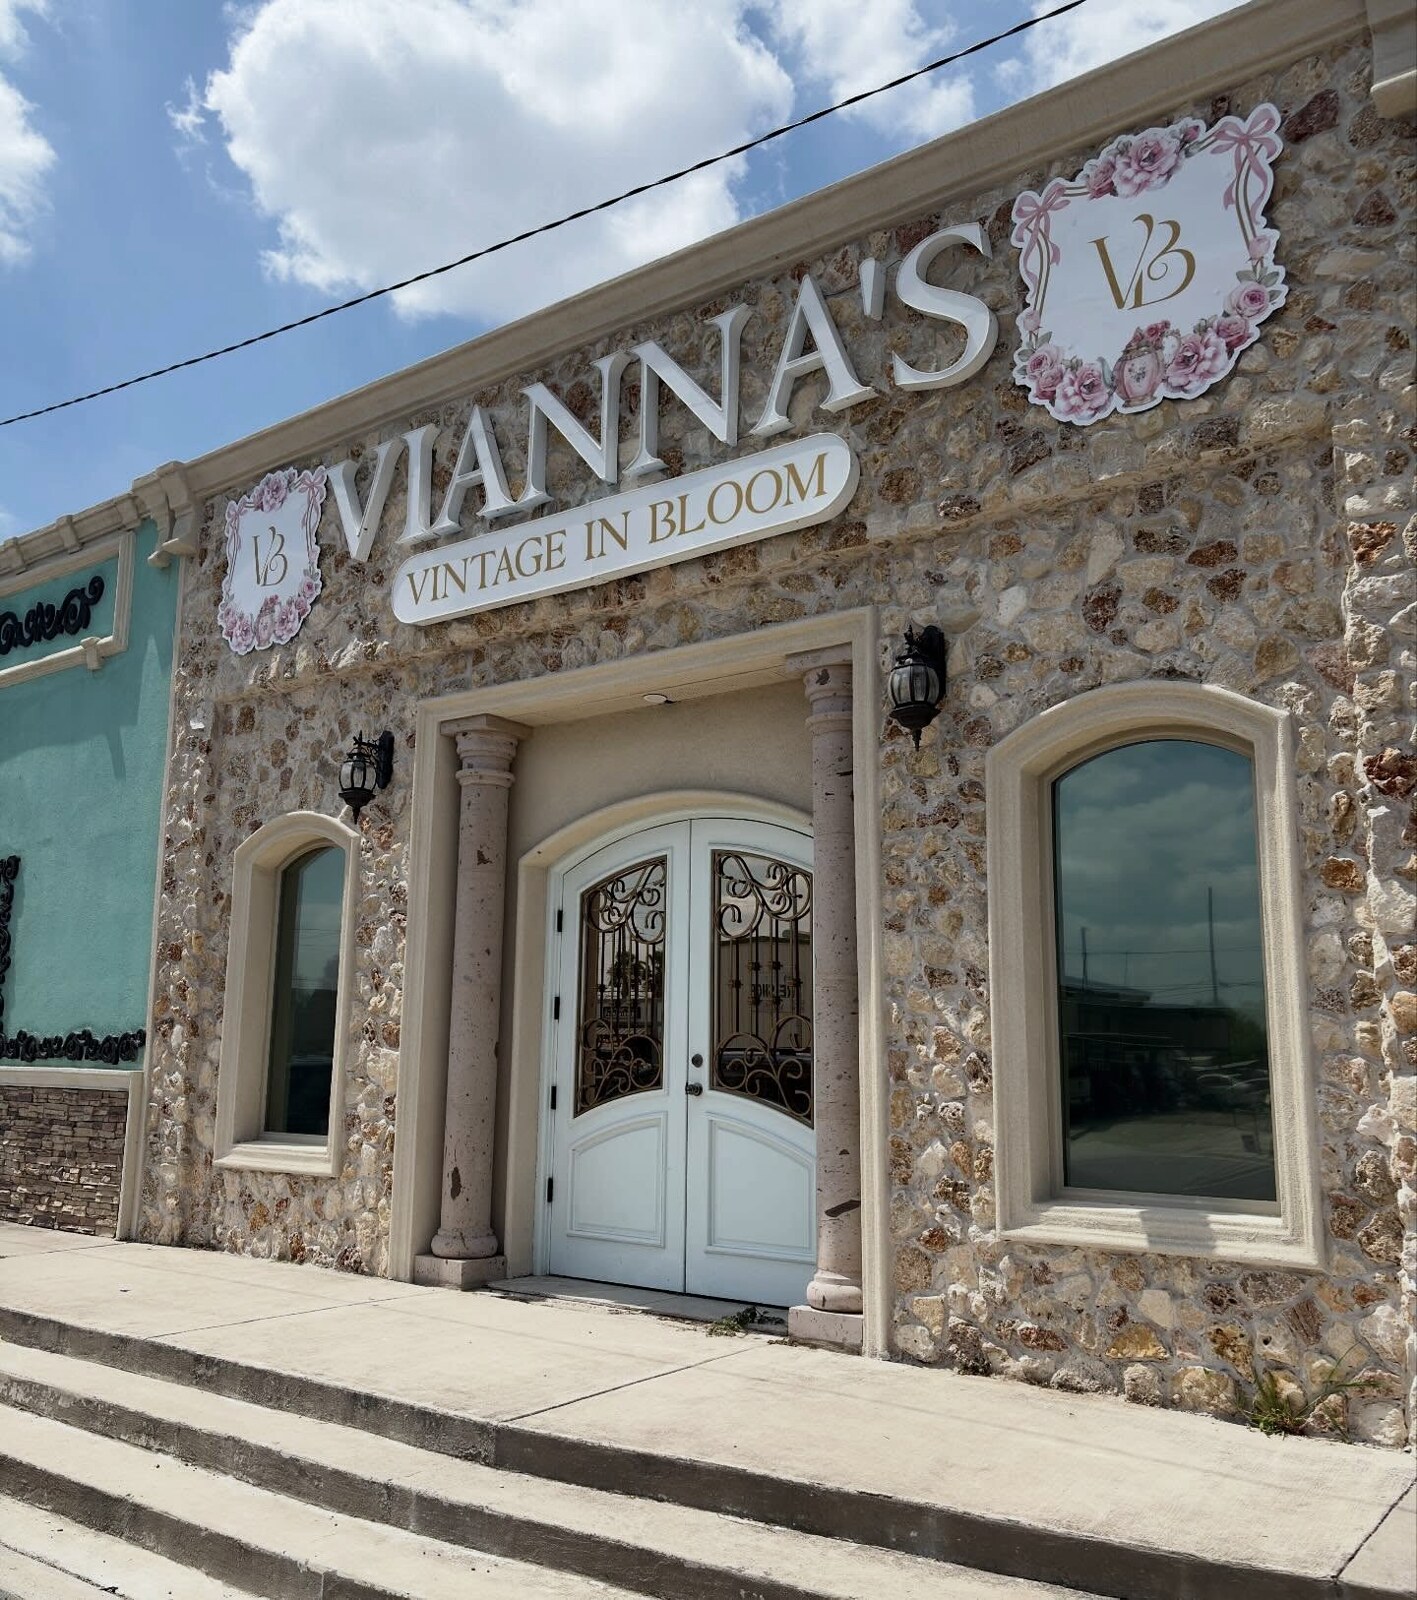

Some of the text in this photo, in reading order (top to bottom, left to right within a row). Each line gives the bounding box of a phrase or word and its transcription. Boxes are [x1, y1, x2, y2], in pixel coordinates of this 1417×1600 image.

[1088, 213, 1196, 311] VB
[327, 221, 999, 562] VIANNA'S
[406, 453, 828, 605] VINTAGE IN BLOOM
